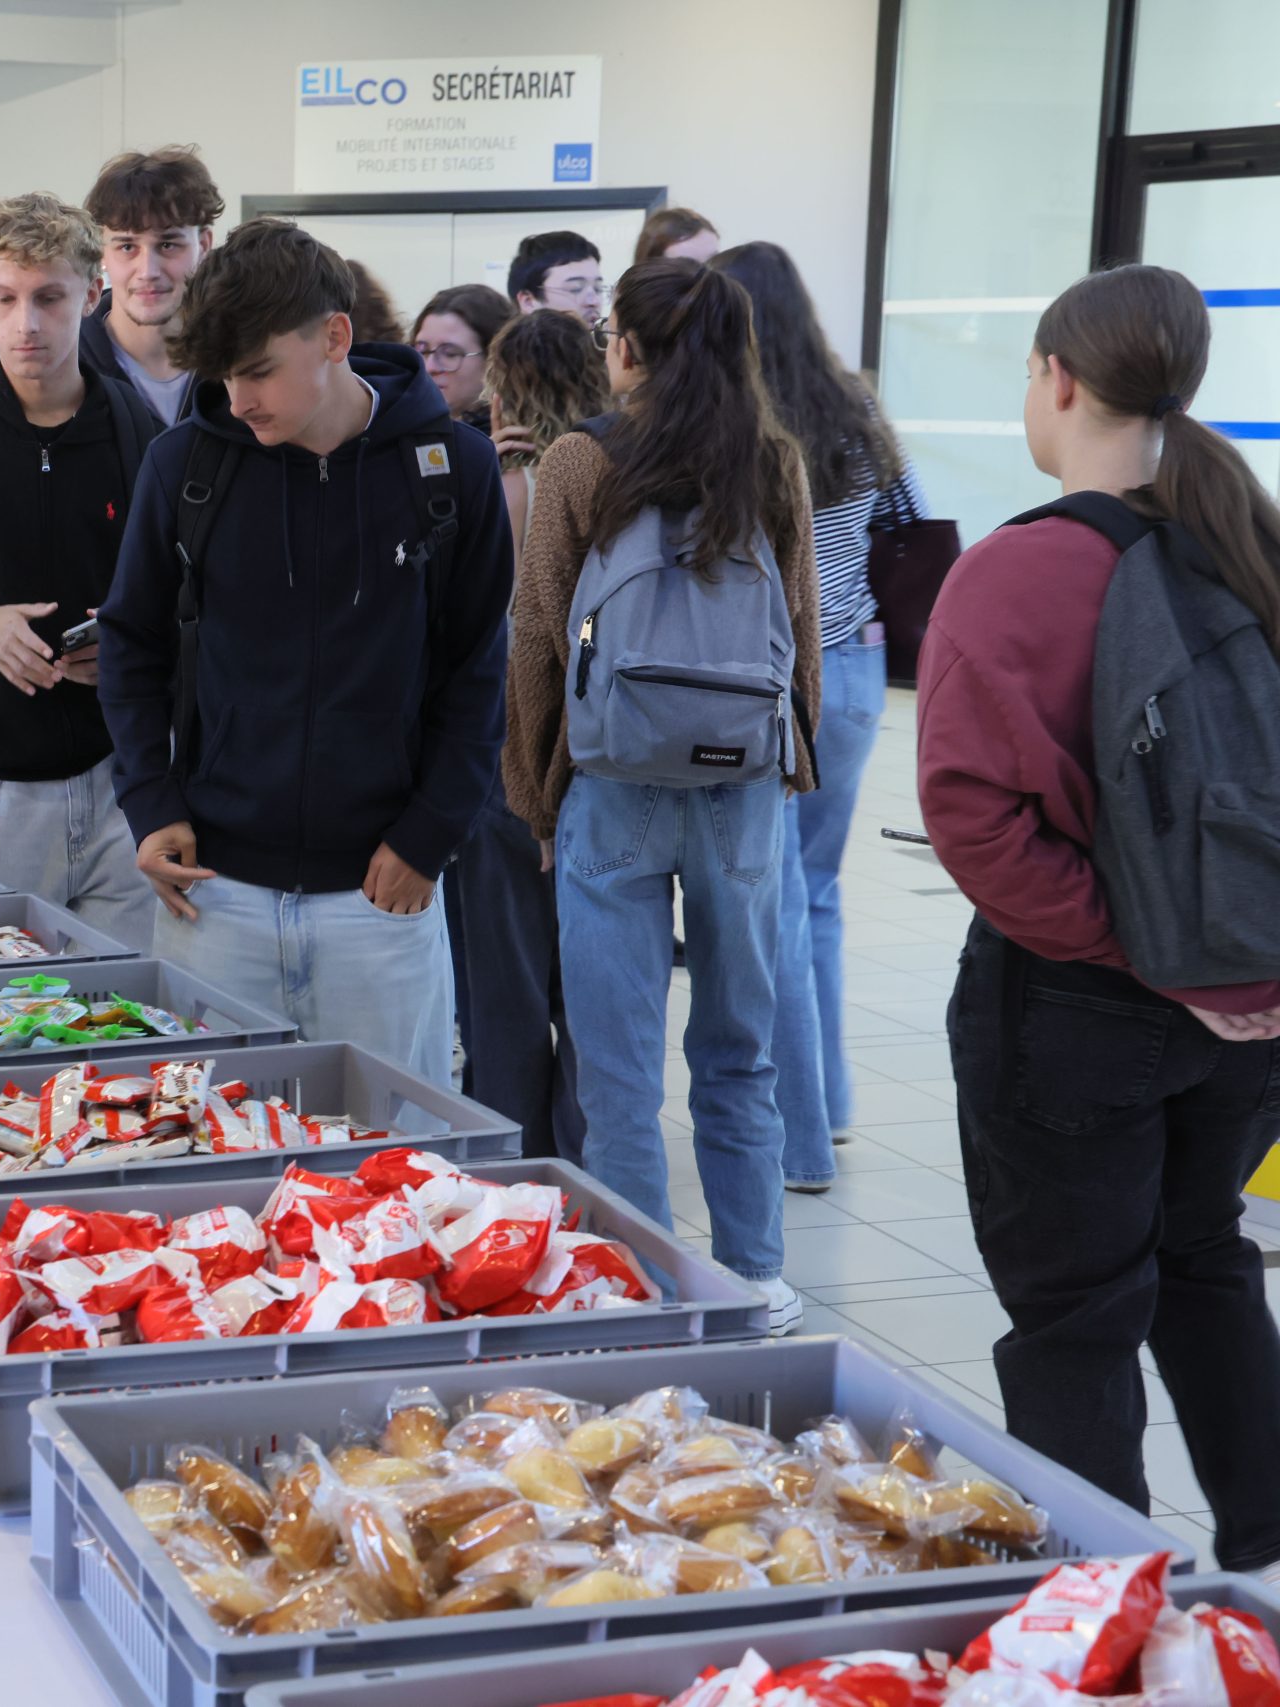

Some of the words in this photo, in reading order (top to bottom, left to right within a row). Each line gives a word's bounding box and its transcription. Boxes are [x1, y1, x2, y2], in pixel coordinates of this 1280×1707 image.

[300, 67, 408, 105] EILCO
[432, 66, 575, 101] SECRÉTARIAT
[387, 117, 466, 131] FORMATION
[336, 137, 398, 152] MOBILITÉ
[403, 135, 517, 151] INTERNATIONALE
[357, 158, 417, 173] PROJETS
[421, 157, 438, 172] ET
[442, 156, 496, 171] STAGES
[700, 752, 738, 761] EASTPAK
